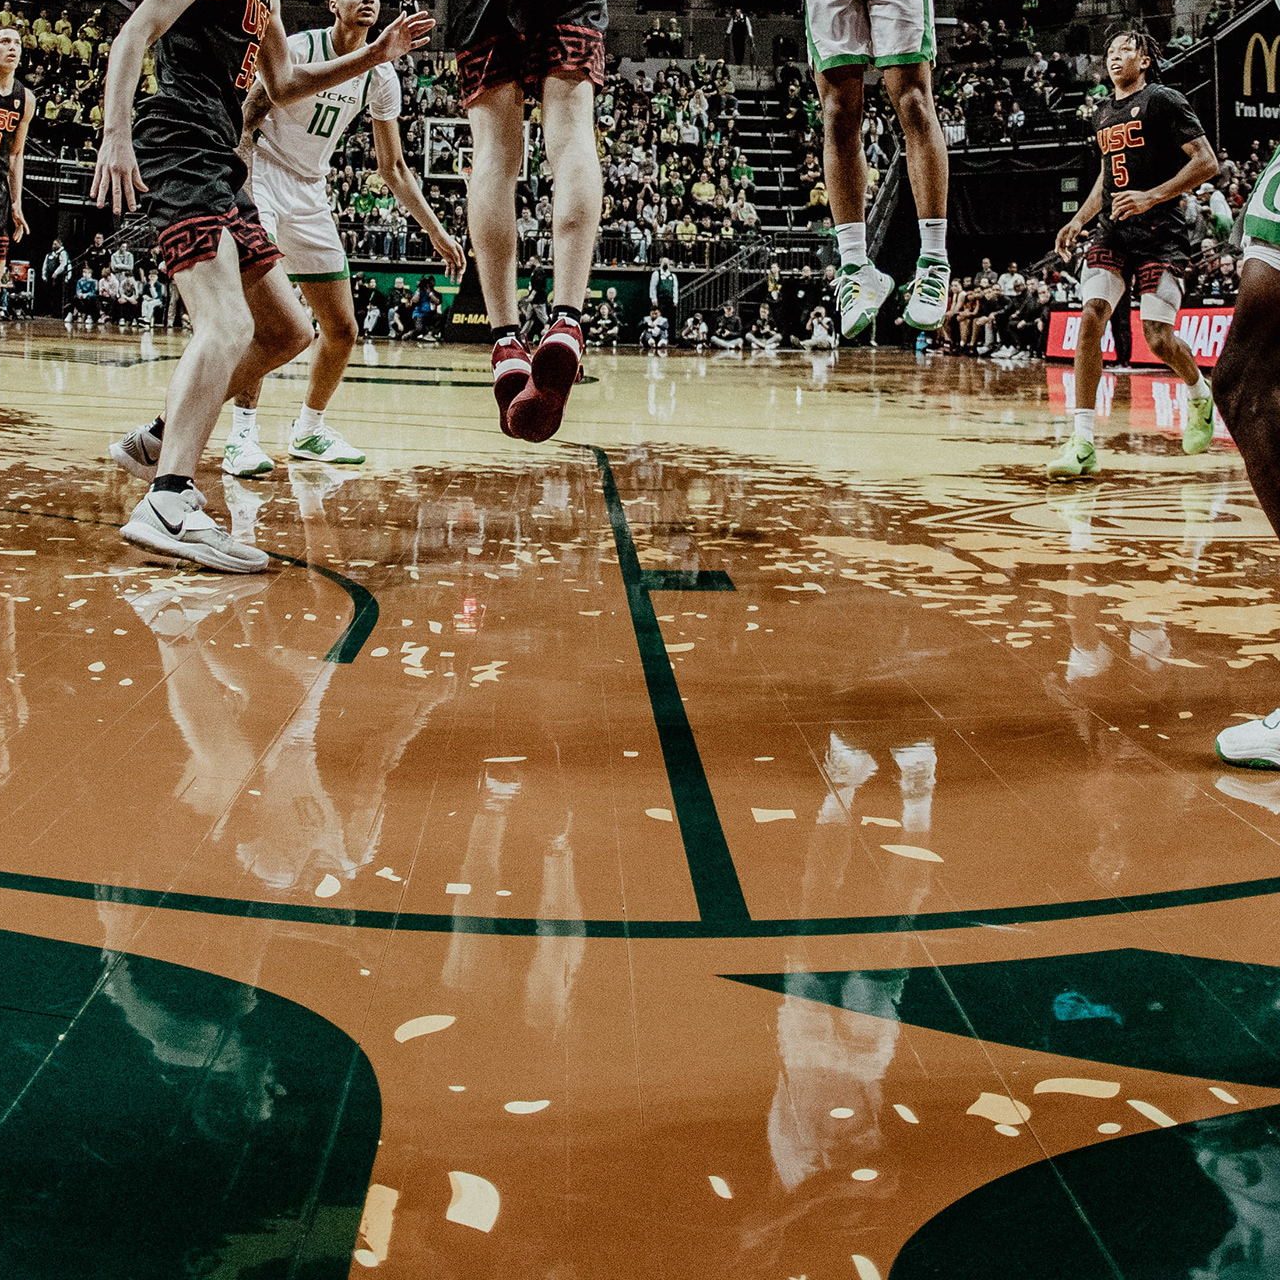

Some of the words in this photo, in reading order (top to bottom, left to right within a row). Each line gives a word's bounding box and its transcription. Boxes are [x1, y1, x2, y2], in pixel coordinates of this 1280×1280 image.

[307, 102, 341, 138] 10
[1097, 120, 1145, 155] USC
[1110, 152, 1129, 188] 5
